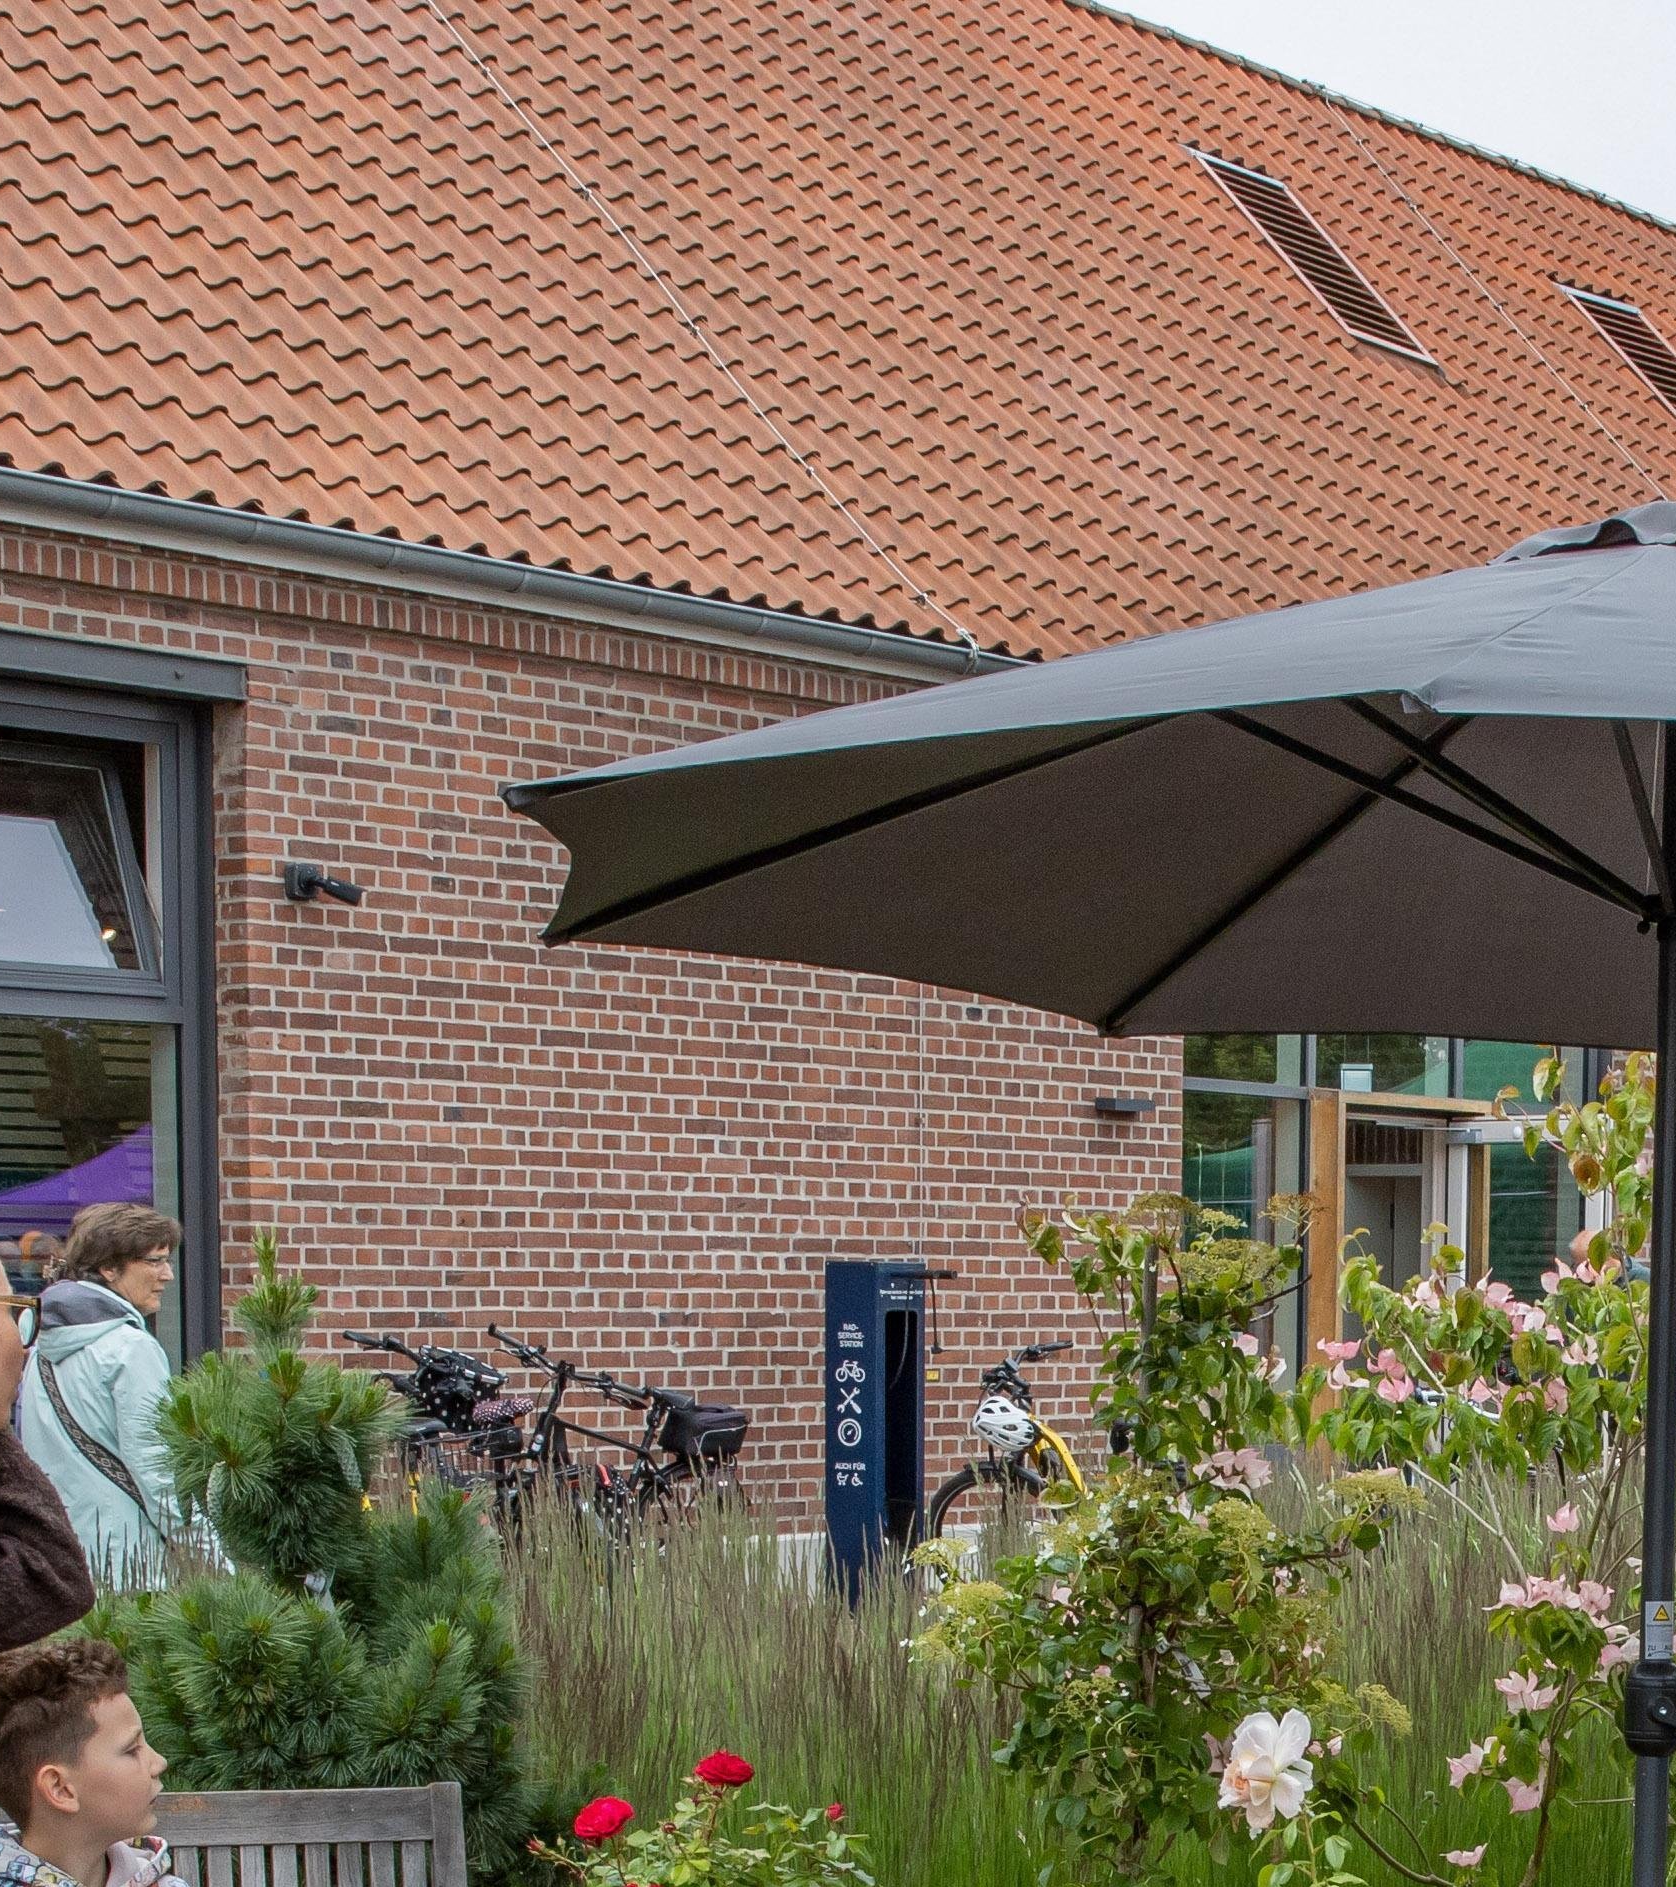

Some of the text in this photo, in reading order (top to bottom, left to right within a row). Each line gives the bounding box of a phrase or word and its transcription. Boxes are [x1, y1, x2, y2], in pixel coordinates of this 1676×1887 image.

[839, 1340, 864, 1348] STATION
[835, 1461, 866, 1471] AUCH FÜR
